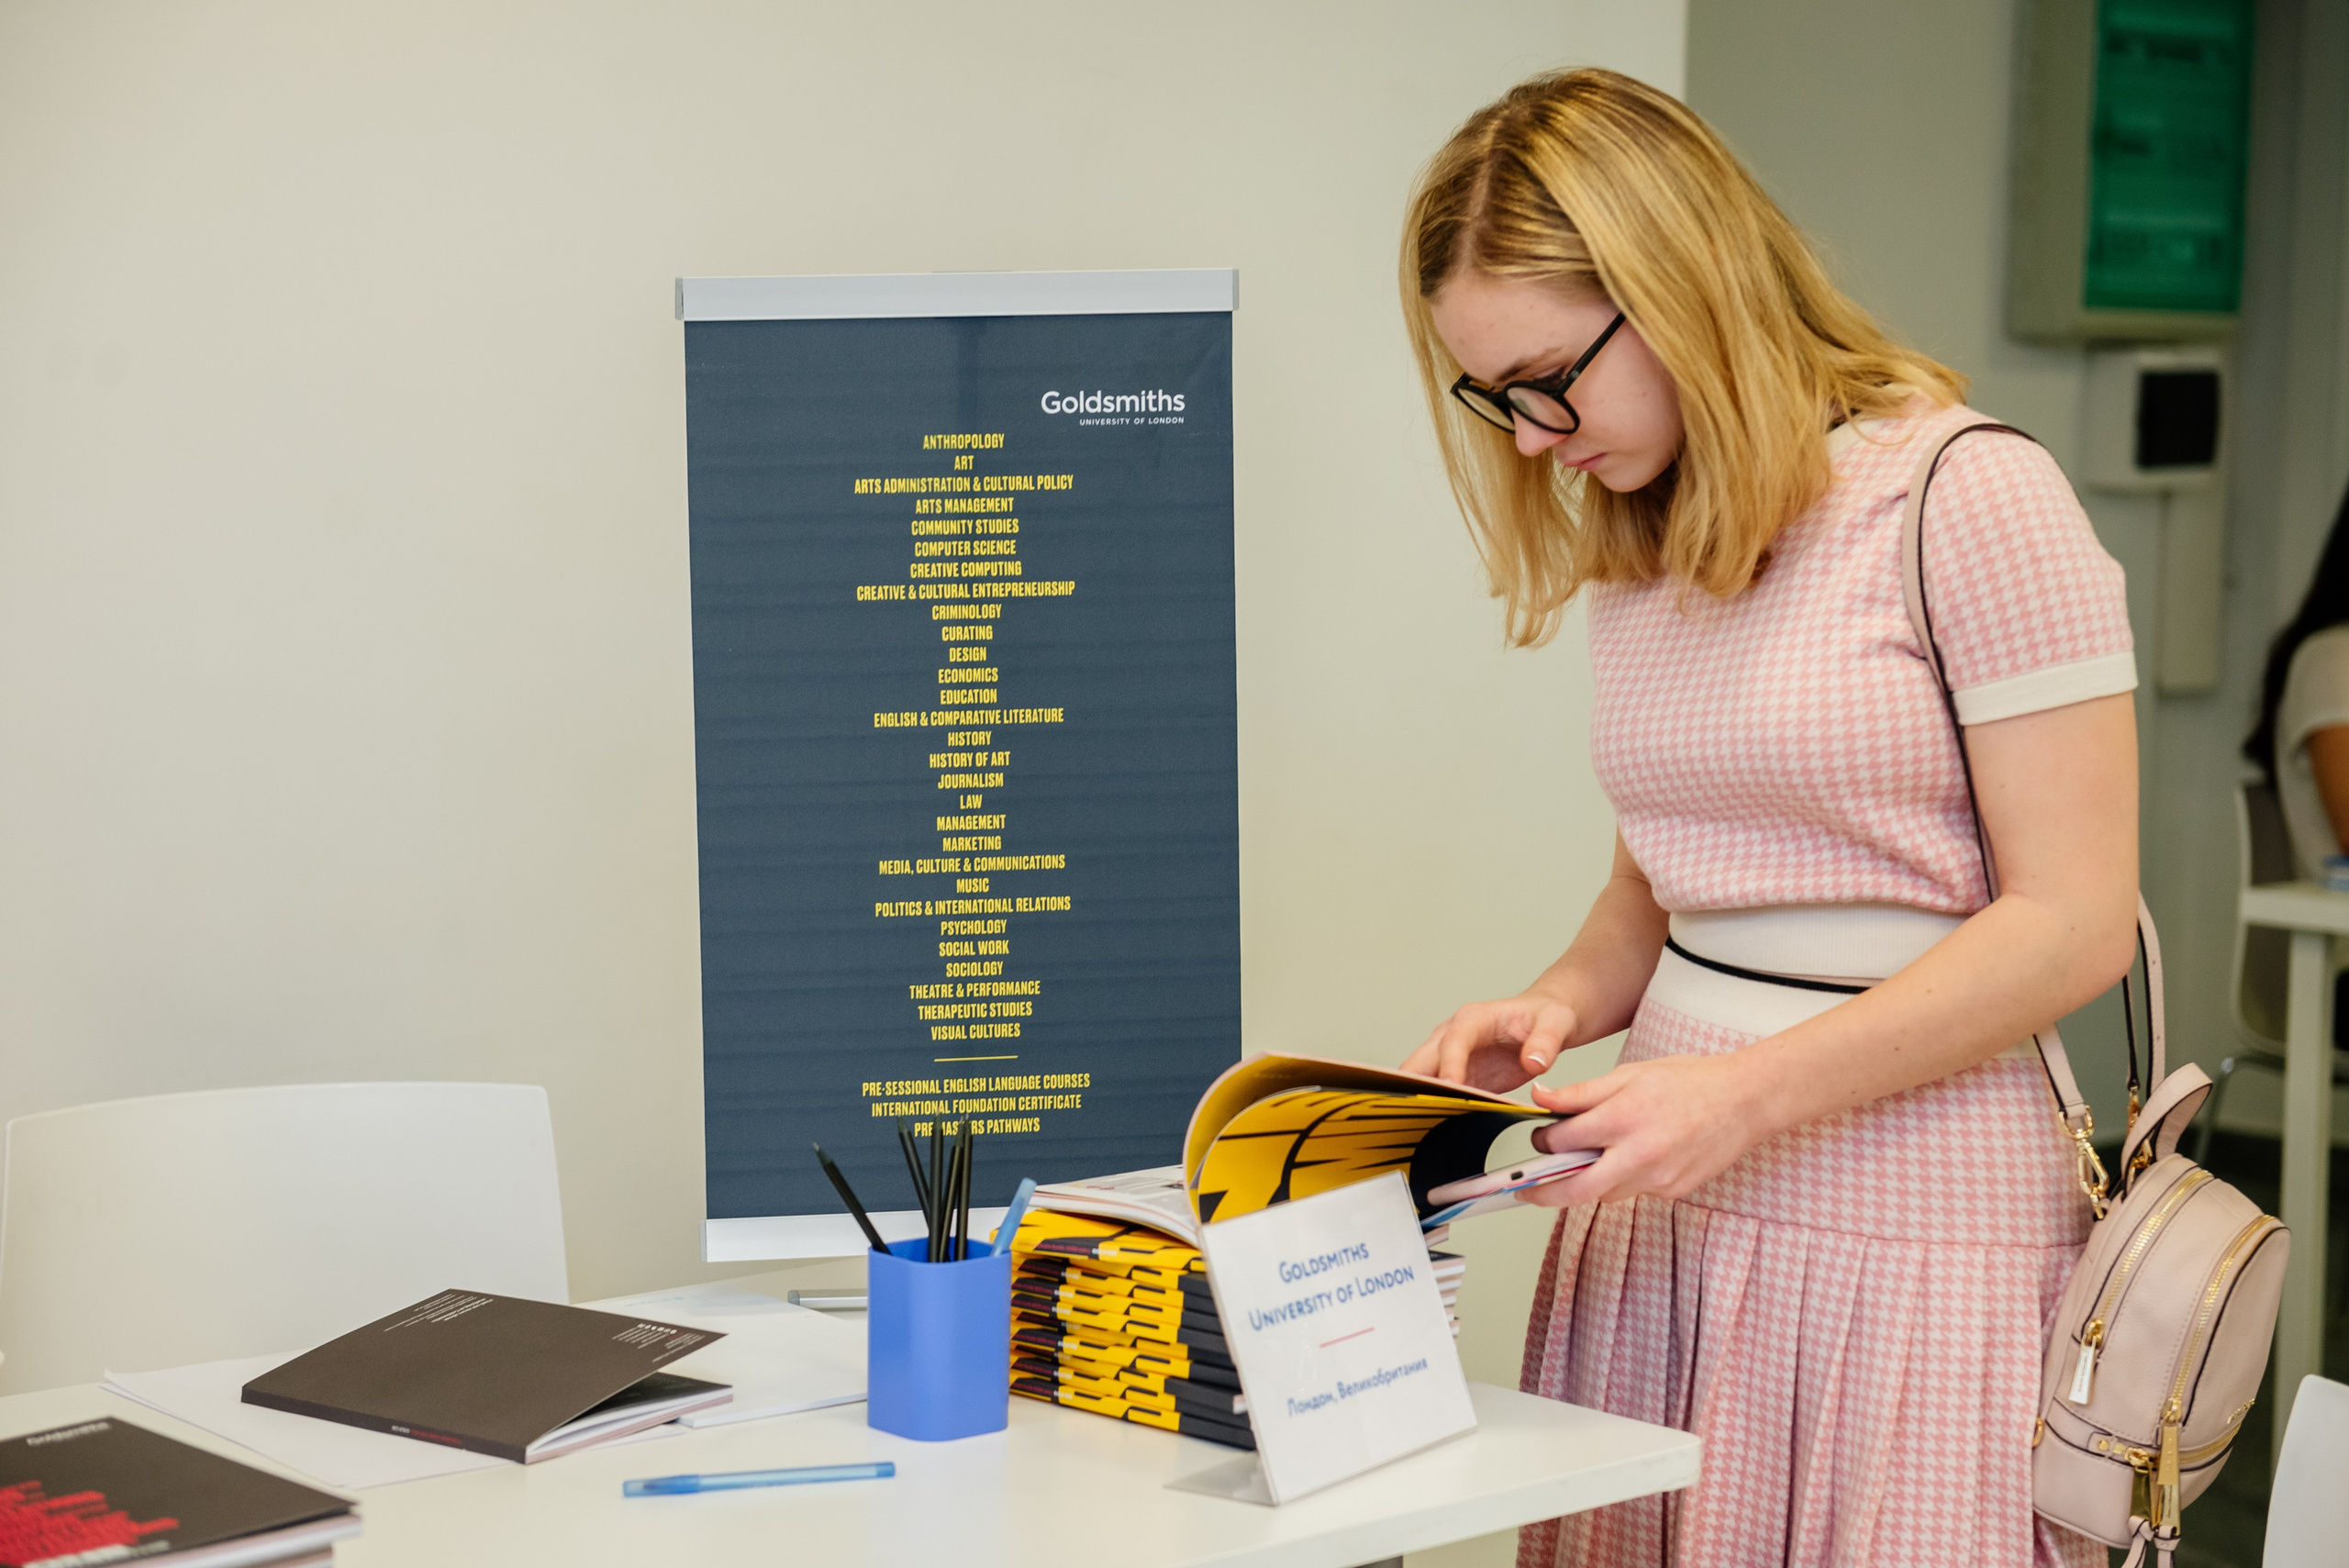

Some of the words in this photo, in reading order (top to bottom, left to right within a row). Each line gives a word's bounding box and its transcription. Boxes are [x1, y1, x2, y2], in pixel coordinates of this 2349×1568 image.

[1041, 389, 1186, 415] Goldsmiths
[1079, 417, 1131, 426] UNIVERSITY
[1133, 417, 1145, 425] OF
[1148, 417, 1185, 425] LONDON
[923, 433, 1005, 450] ANTHROPOLOGY
[954, 455, 974, 470] ART
[854, 478, 882, 494] ARTS
[884, 477, 970, 494] ADMINISTRATION
[973, 476, 981, 492] &
[984, 475, 1035, 492] CULTURAL
[1037, 474, 1074, 490] POLICY
[916, 498, 942, 514] ARTS
[944, 497, 1014, 513] MANAGEMENT
[911, 519, 973, 536] COMMUNITY
[975, 518, 1019, 534] STUDIES
[915, 540, 971, 557] COMPUTER
[973, 539, 1017, 555] SCIENCE
[910, 562, 959, 578] CREATIVE
[961, 561, 1022, 577] COMPUTING
[857, 584, 906, 601] CREATIVE
[908, 584, 917, 600] &
[918, 584, 971, 599] CULTURAL
[973, 581, 1075, 598] ENTREPRENEURSHIP
[932, 604, 1001, 620] CRIMINOLOGY
[941, 625, 993, 641] CURATING
[949, 647, 986, 662] DESIGN
[938, 667, 998, 684] ECONOMICS
[941, 688, 997, 705] EDUCATION
[874, 712, 918, 728] ENGLISH
[919, 711, 929, 727] &
[930, 709, 1001, 727] COMPARATIVE
[1003, 707, 1064, 724] LITERATURE
[948, 731, 991, 746] HISTORY
[930, 752, 973, 768] HISTORY
[975, 751, 988, 767] OF
[991, 751, 1010, 766] ART
[938, 773, 1004, 789] JOURNALISM
[960, 795, 982, 809] LAW
[937, 814, 1006, 831] MANAGEMENT
[942, 836, 1001, 851] MARKETING
[879, 860, 914, 875] MEDIA,
[916, 858, 961, 873] CULTURE
[963, 858, 972, 872] &
[974, 854, 1065, 872] COMMUNICATIONS
[956, 878, 989, 894] MUSIC
[875, 901, 922, 917] POLITICS
[924, 901, 933, 916] &
[935, 898, 1014, 915] INTERNATIONAL
[1016, 895, 1071, 912] RELATIONS
[941, 919, 1007, 936] PSYCHOLOGY
[939, 941, 975, 957] SOCIAL
[977, 940, 1009, 955] WORK
[946, 961, 1003, 977] SOCIOLOGY
[909, 984, 953, 999] THEATRE
[956, 984, 964, 997] &
[966, 981, 1041, 997] PERFORMANCE
[918, 1003, 987, 1020] THERAPEUTIC
[989, 1001, 1032, 1018] STUDIES
[930, 1025, 967, 1040] VISUAL
[969, 1023, 1020, 1039] CULTURES
[863, 1079, 941, 1096] PRE-SESSIONAL
[943, 1077, 986, 1094] ENGLISH
[988, 1075, 1041, 1091] LANGUAGE
[1043, 1073, 1090, 1089] COURSES
[872, 1100, 951, 1117] INTERNATIONAL
[952, 1097, 1016, 1115] FOUNDATION
[1019, 1095, 1081, 1111] CERTIFICATE
[914, 1119, 985, 1137] PREASRS
[986, 1118, 1040, 1134] PATHWAYS
[1279, 1242, 1370, 1284] GOLDSMITHS
[1248, 1291, 1333, 1331] UNIVERSITY
[1336, 1284, 1354, 1304] OF
[1355, 1265, 1415, 1297] LONDON
[1336, 1358, 1428, 1400] Великобритания
